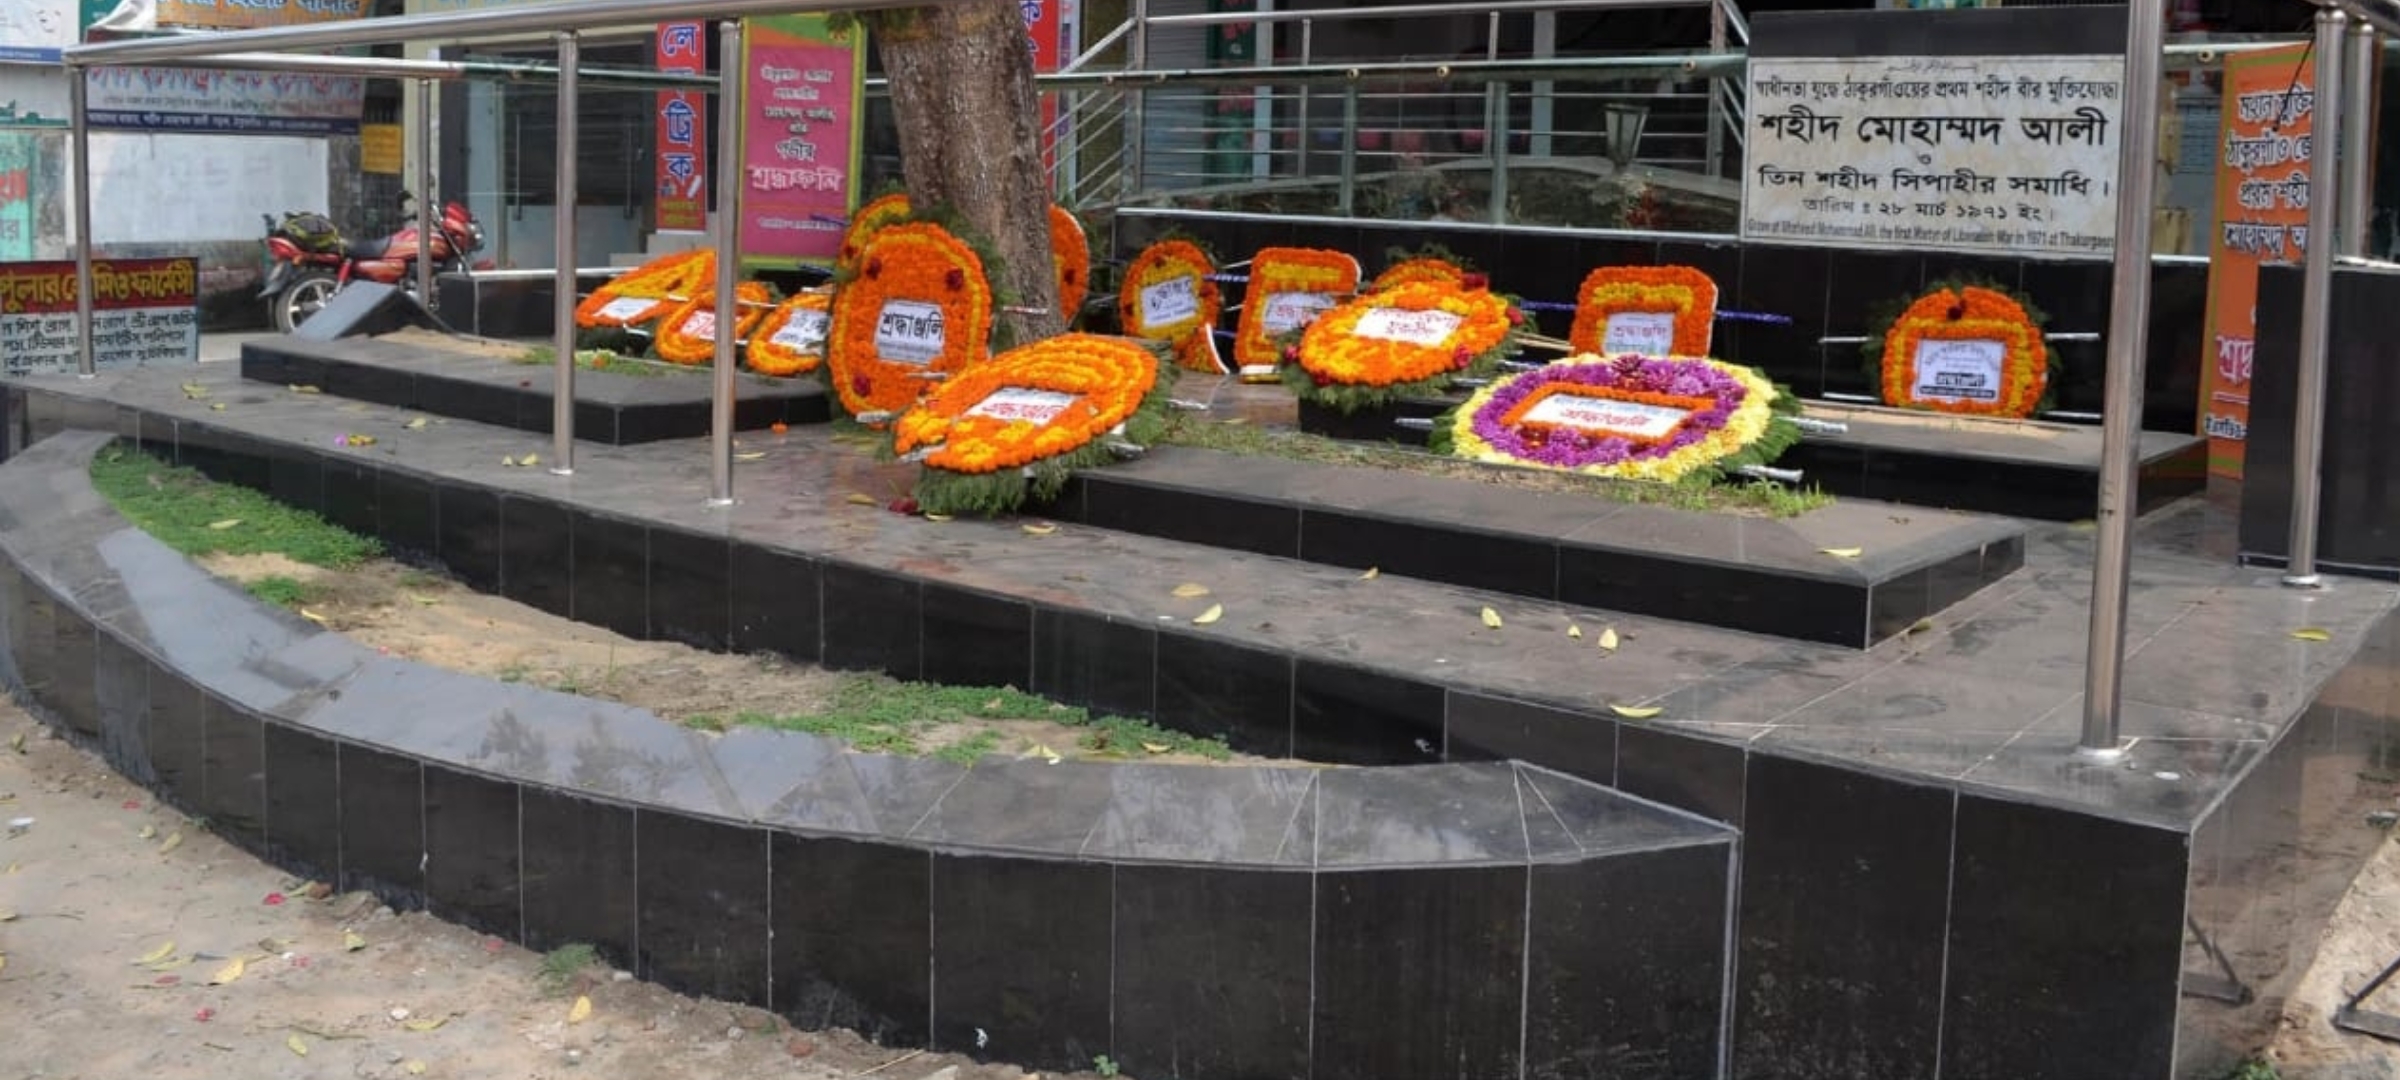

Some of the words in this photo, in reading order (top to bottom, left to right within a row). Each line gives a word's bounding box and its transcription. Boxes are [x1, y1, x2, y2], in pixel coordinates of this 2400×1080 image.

[1934, 80, 1970, 99] প্রথম
[1974, 74, 2011, 100] শহীদ
[2016, 75, 2042, 98] বীর
[1757, 104, 1843, 144] শহীদ
[1857, 115, 2005, 148] মোহাম্মদ
[2019, 106, 2109, 146] আলী
[1917, 153, 1932, 165] ও
[1758, 164, 1805, 188] তিন
[1815, 165, 1880, 190] শহীদ
[1892, 167, 1998, 194] সিপাহীর
[2006, 169, 2092, 196] সমাধি
[1879, 202, 1905, 216] ২৮
[1956, 204, 2008, 219] ১৯৭১
